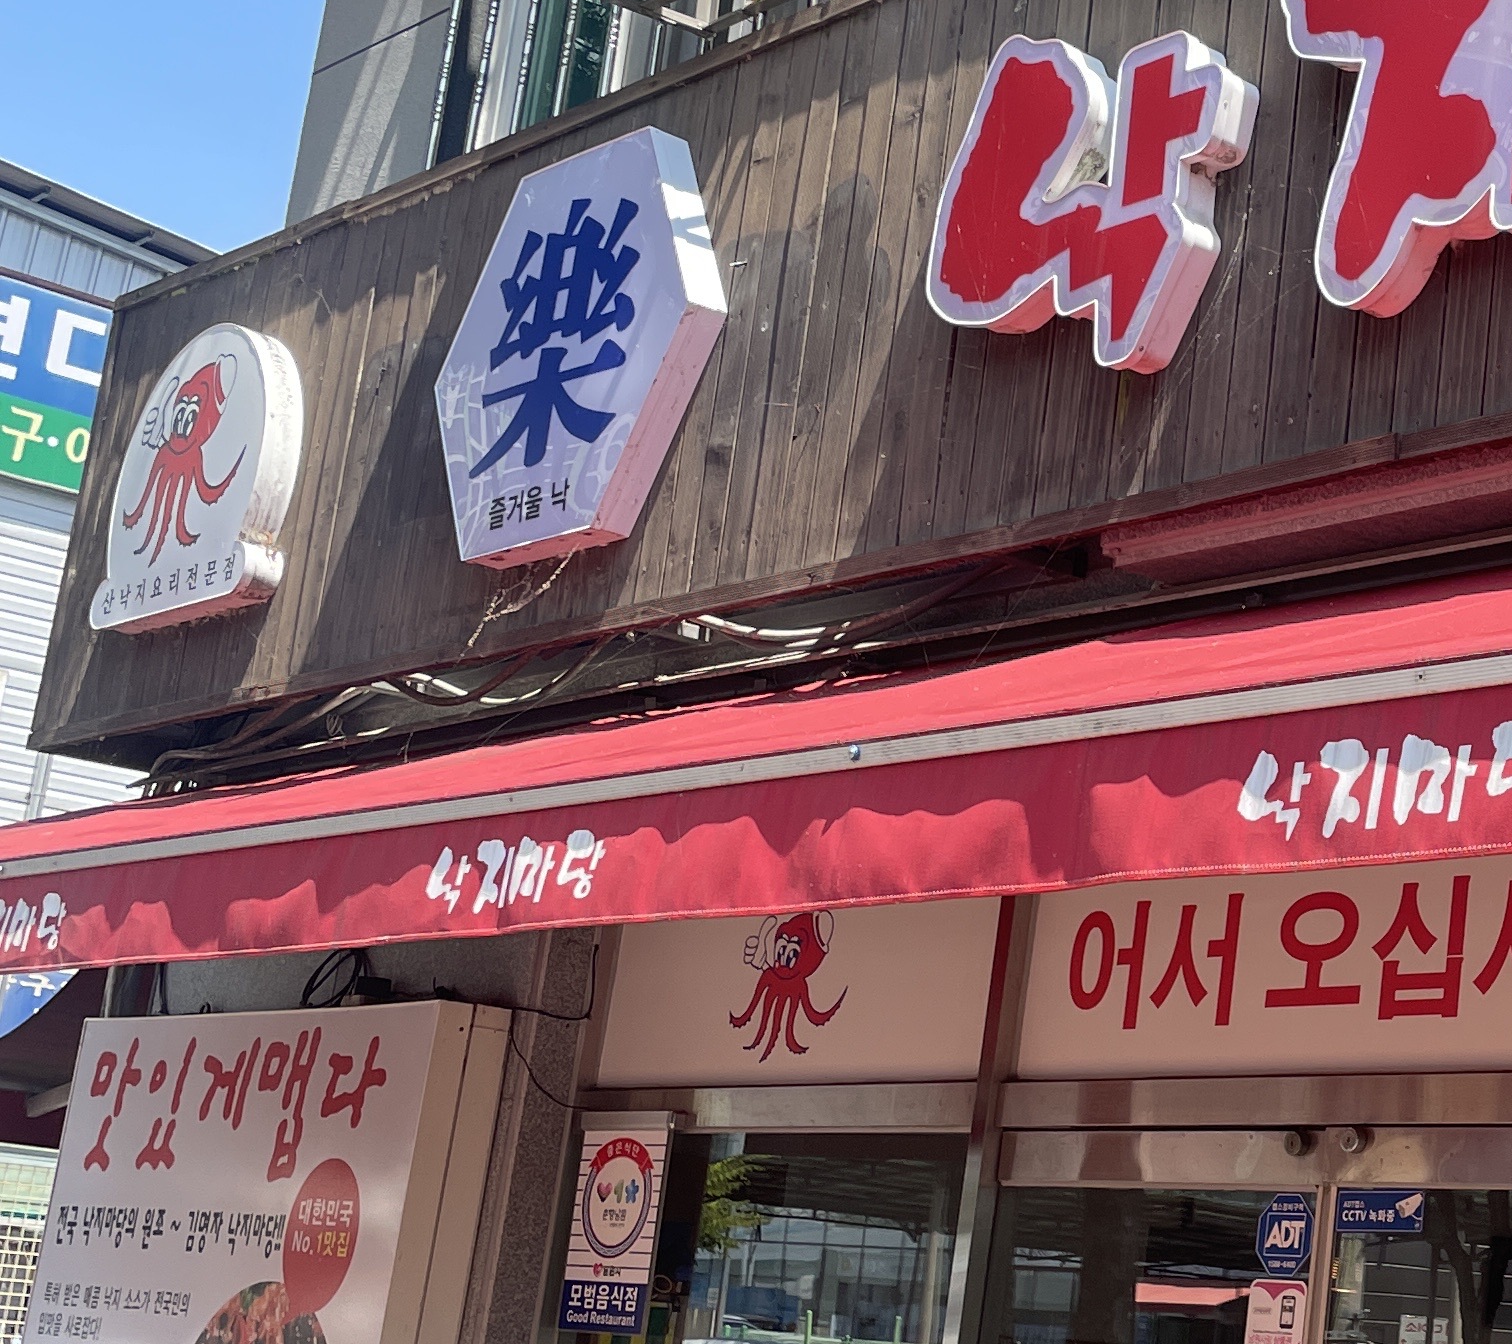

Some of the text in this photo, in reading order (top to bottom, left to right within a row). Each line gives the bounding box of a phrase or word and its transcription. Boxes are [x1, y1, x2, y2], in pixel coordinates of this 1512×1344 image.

[469, 198, 641, 478] 樂
[489, 478, 570, 530] 즐거울 낙
[102, 554, 236, 615] 산낙지요리전문점
[426, 829, 606, 914] 낙지마당
[1069, 893, 1244, 1030] 어서
[56, 1205, 78, 1245] 전국
[83, 1206, 139, 1248] 낙지마당의
[142, 1208, 165, 1249] 원조
[185, 1210, 224, 1253] 김명자
[298, 1198, 354, 1228] 대한민국
[1342, 1209, 1395, 1223] CCTV 녹화중
[1264, 1220, 1305, 1249] ADT
[104, 1286, 122, 1311] 낙지
[124, 1288, 150, 1314] 소스가
[154, 1290, 191, 1317] 전국민의
[568, 1284, 639, 1312] 모범음식점
[567, 1310, 636, 1327] Good Restaurant
